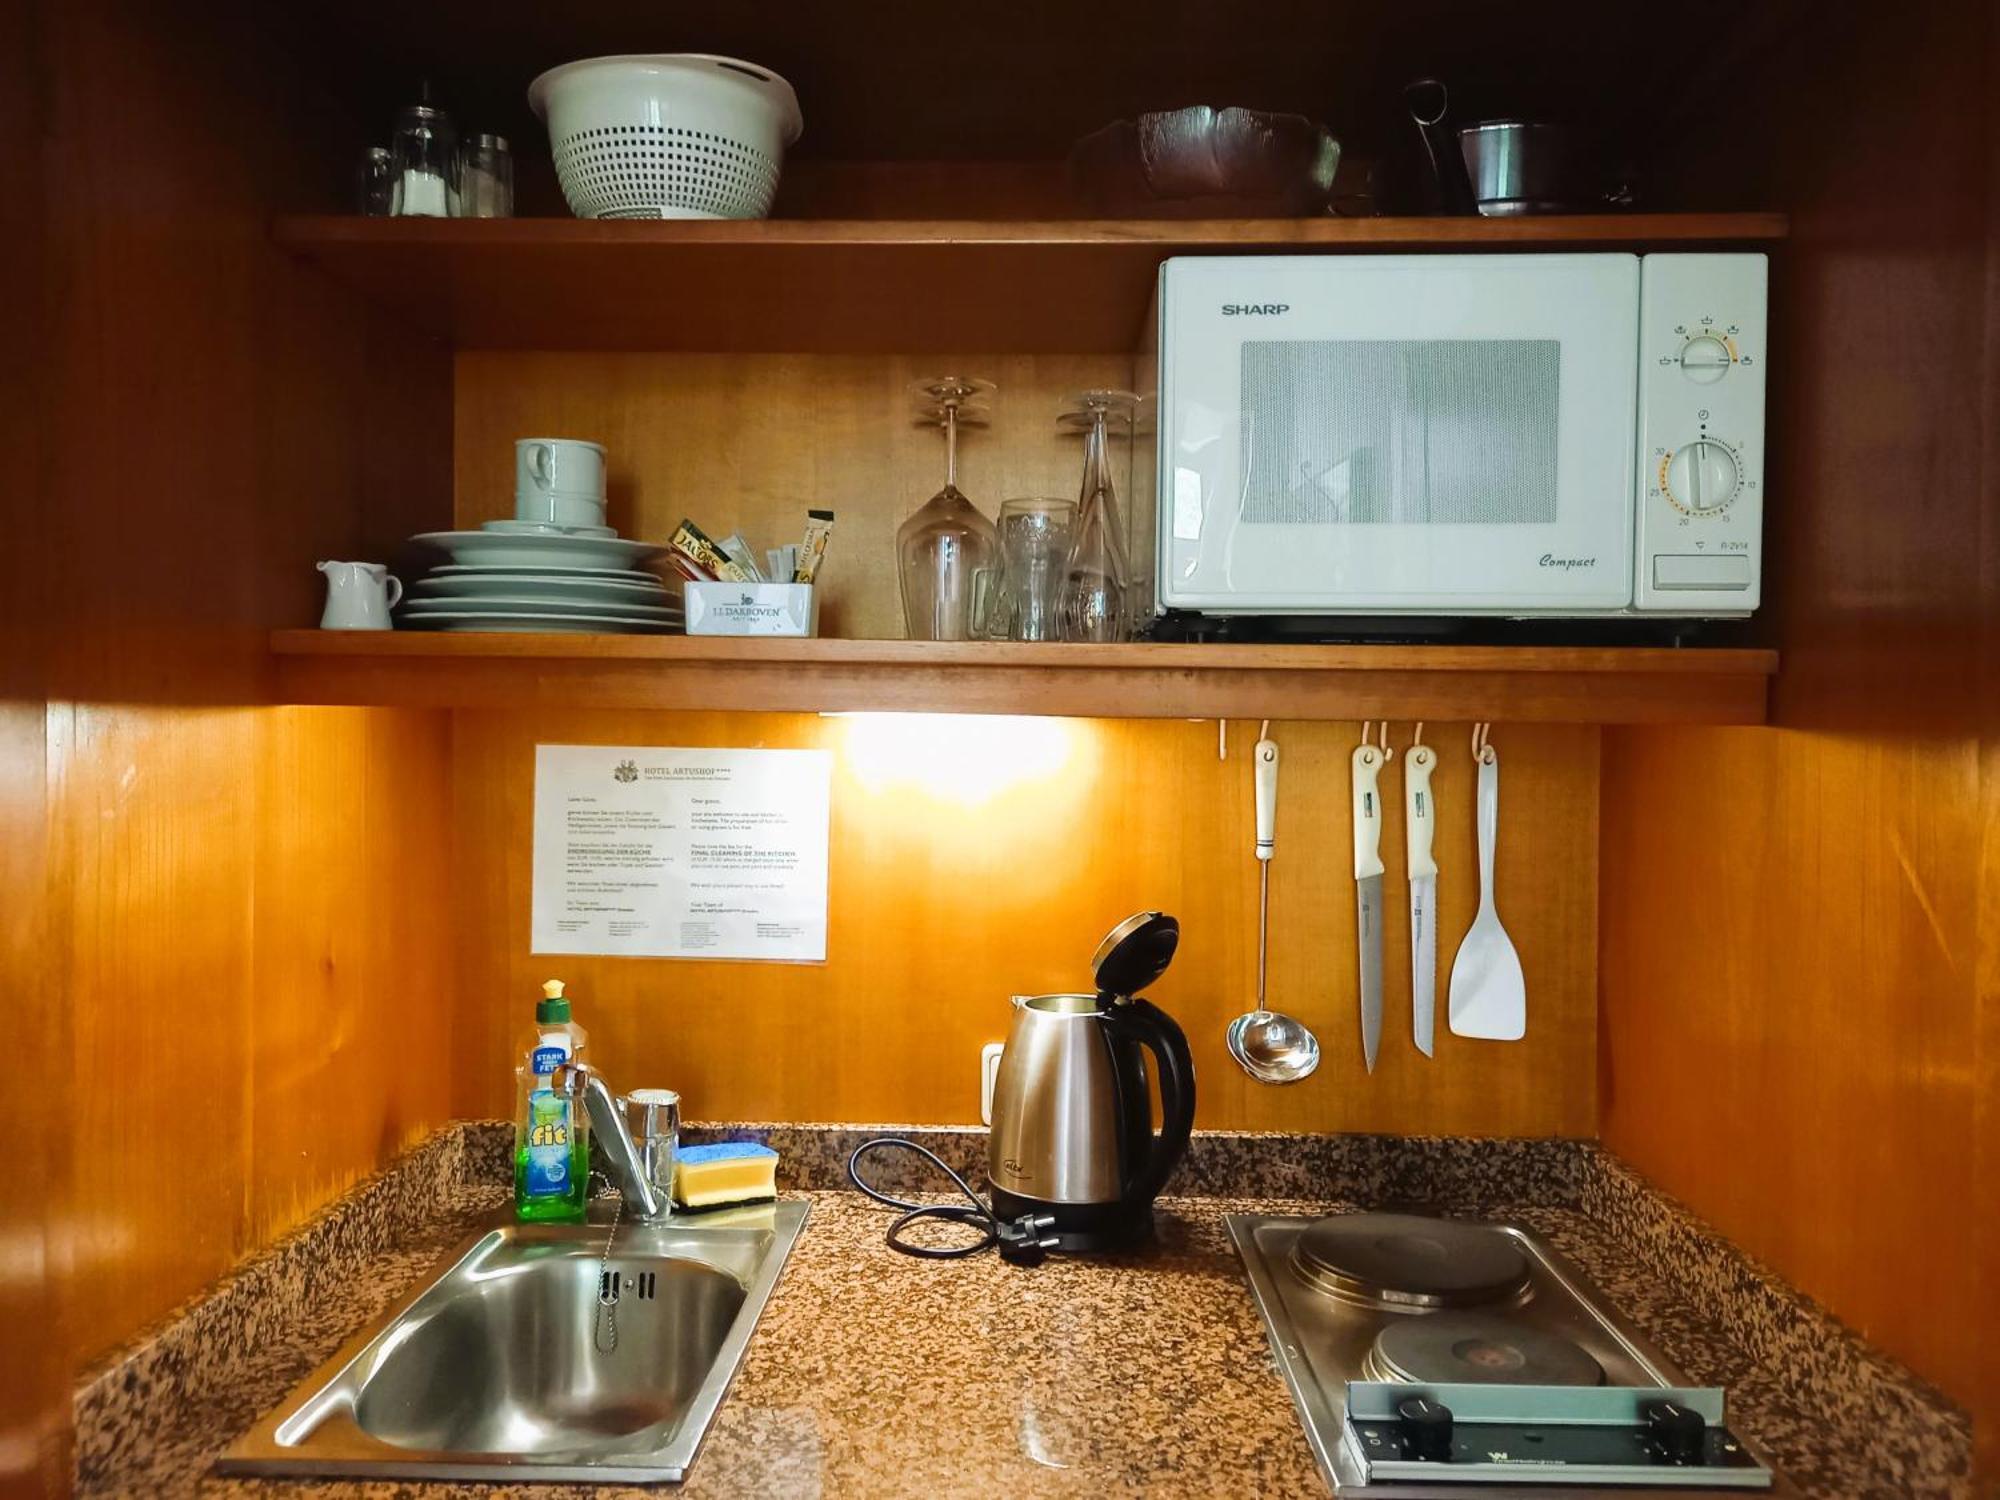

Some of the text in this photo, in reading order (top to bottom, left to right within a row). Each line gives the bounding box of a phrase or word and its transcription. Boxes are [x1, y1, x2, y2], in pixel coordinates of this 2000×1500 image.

[1222, 304, 1290, 315] SHARP
[1747, 481, 1756, 489] 10
[1650, 488, 1660, 497] 25
[1679, 518, 1689, 527] 20
[1722, 514, 1731, 523] 15
[676, 533, 718, 569] JACOBS
[1539, 553, 1596, 571] Compact
[644, 767, 670, 775] HOTEL
[536, 1053, 564, 1061] STARK
[531, 1124, 567, 1147] fit
